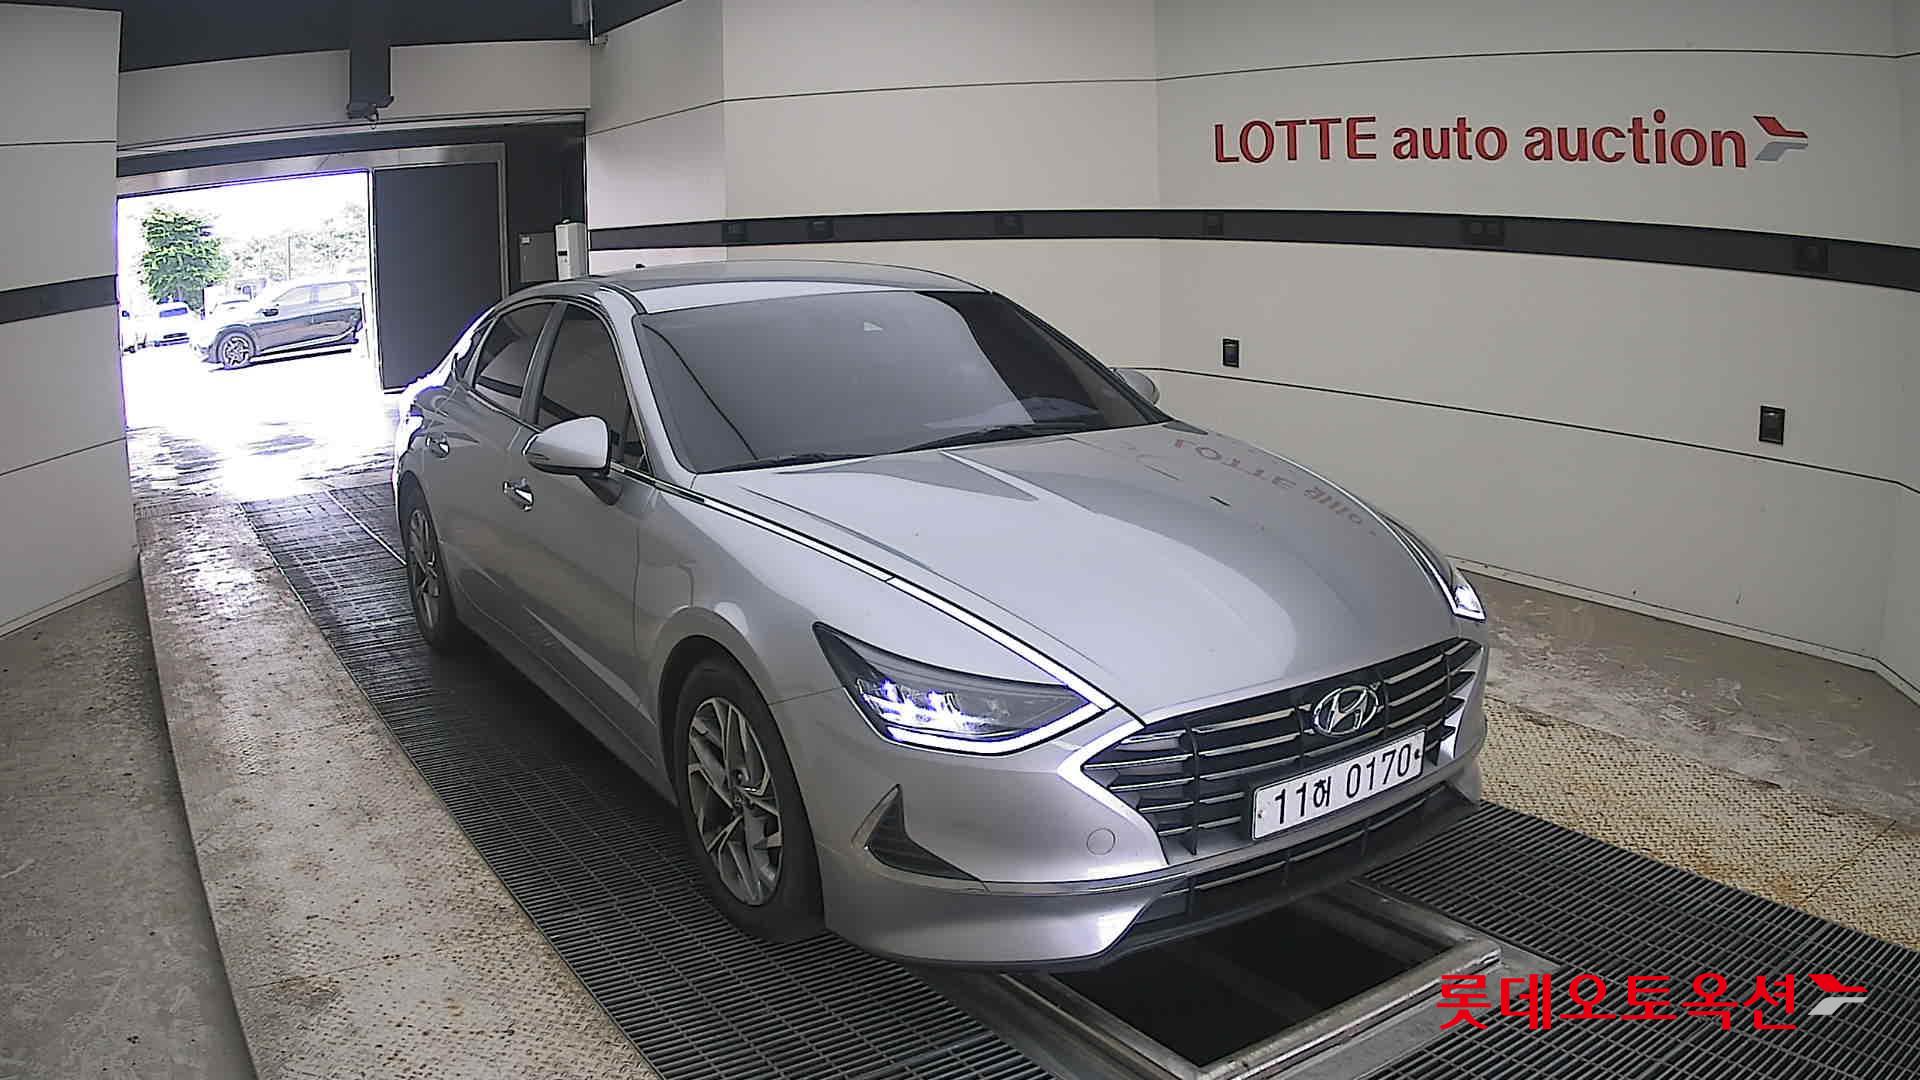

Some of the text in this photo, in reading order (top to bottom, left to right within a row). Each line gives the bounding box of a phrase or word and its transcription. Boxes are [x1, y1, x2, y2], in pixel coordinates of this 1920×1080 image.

[1213, 109, 1748, 169] LOTTE auto auction
[1275, 743, 1412, 825] 11허 0170
